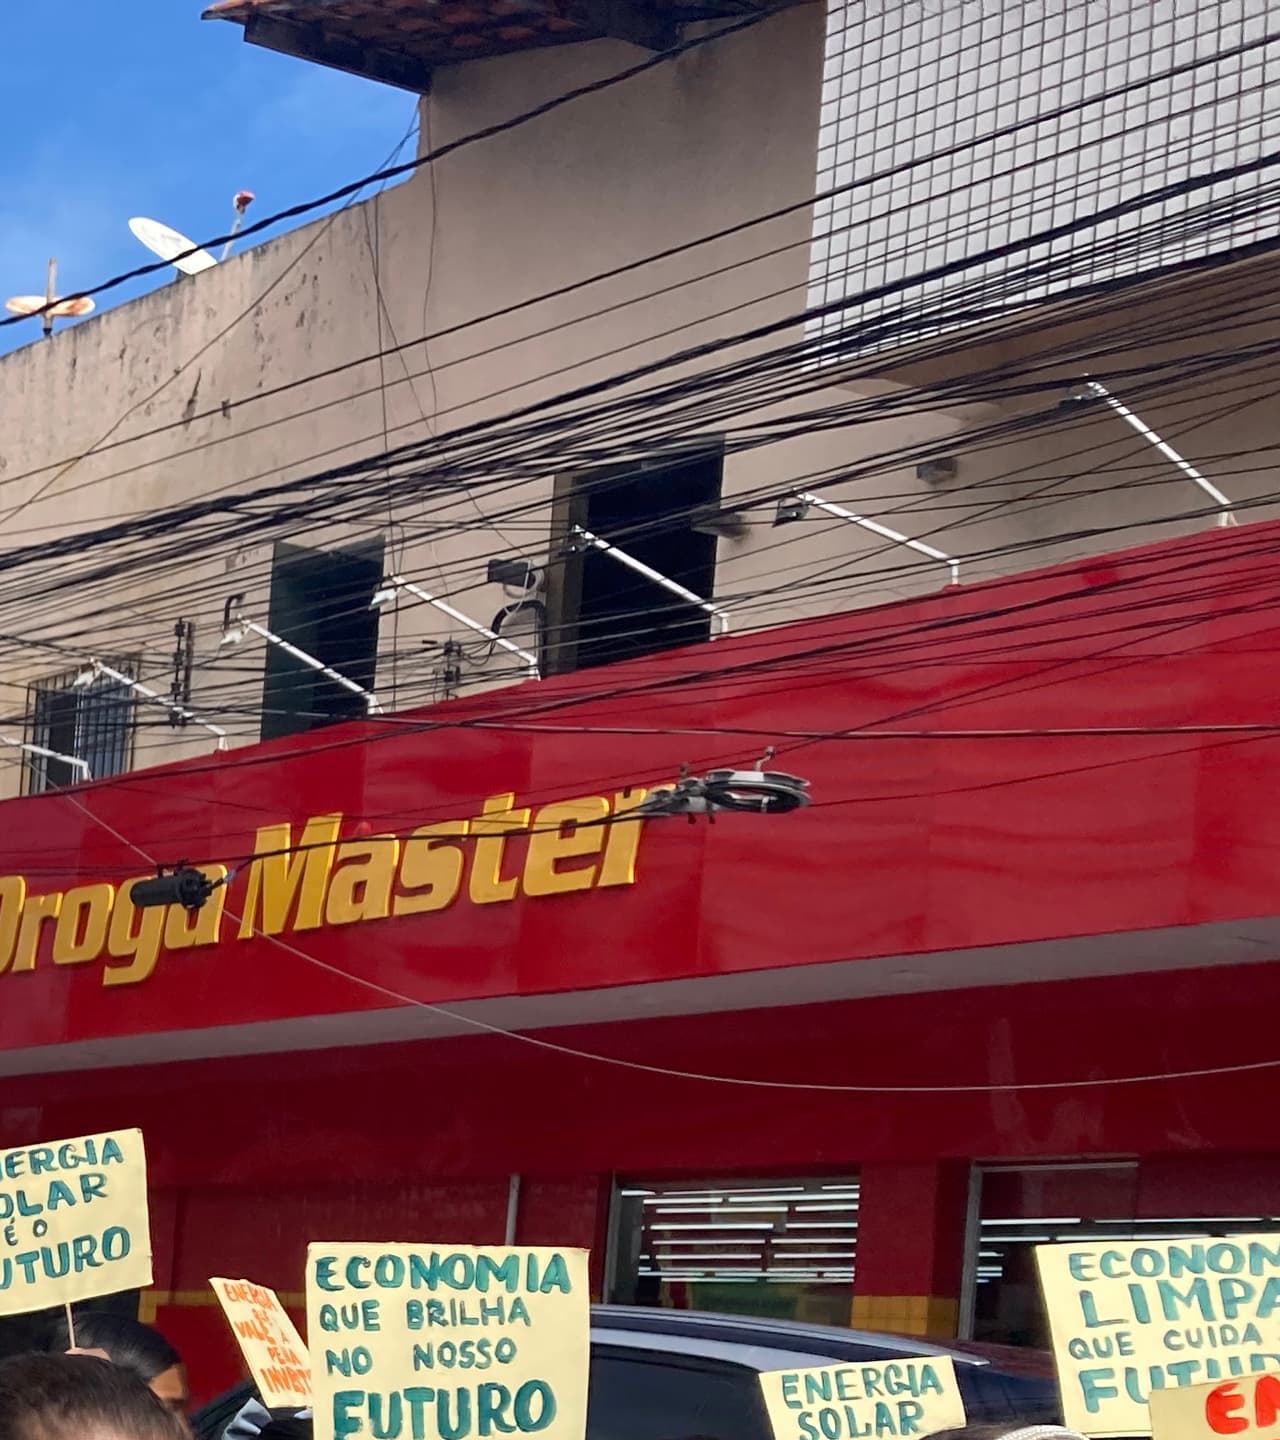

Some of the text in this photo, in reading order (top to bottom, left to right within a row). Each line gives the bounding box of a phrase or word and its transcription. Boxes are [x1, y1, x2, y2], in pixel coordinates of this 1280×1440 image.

[237, 783, 678, 940] Master
[3, 1216, 48, 1246] É O
[315, 1251, 573, 1295] ECONOMIA
[319, 1296, 532, 1332] QUE BRILHA
[325, 1337, 518, 1378] NO NOSSO
[1068, 1322, 1264, 1360] QUE CUIDA
[781, 1363, 945, 1410] ENERGIA
